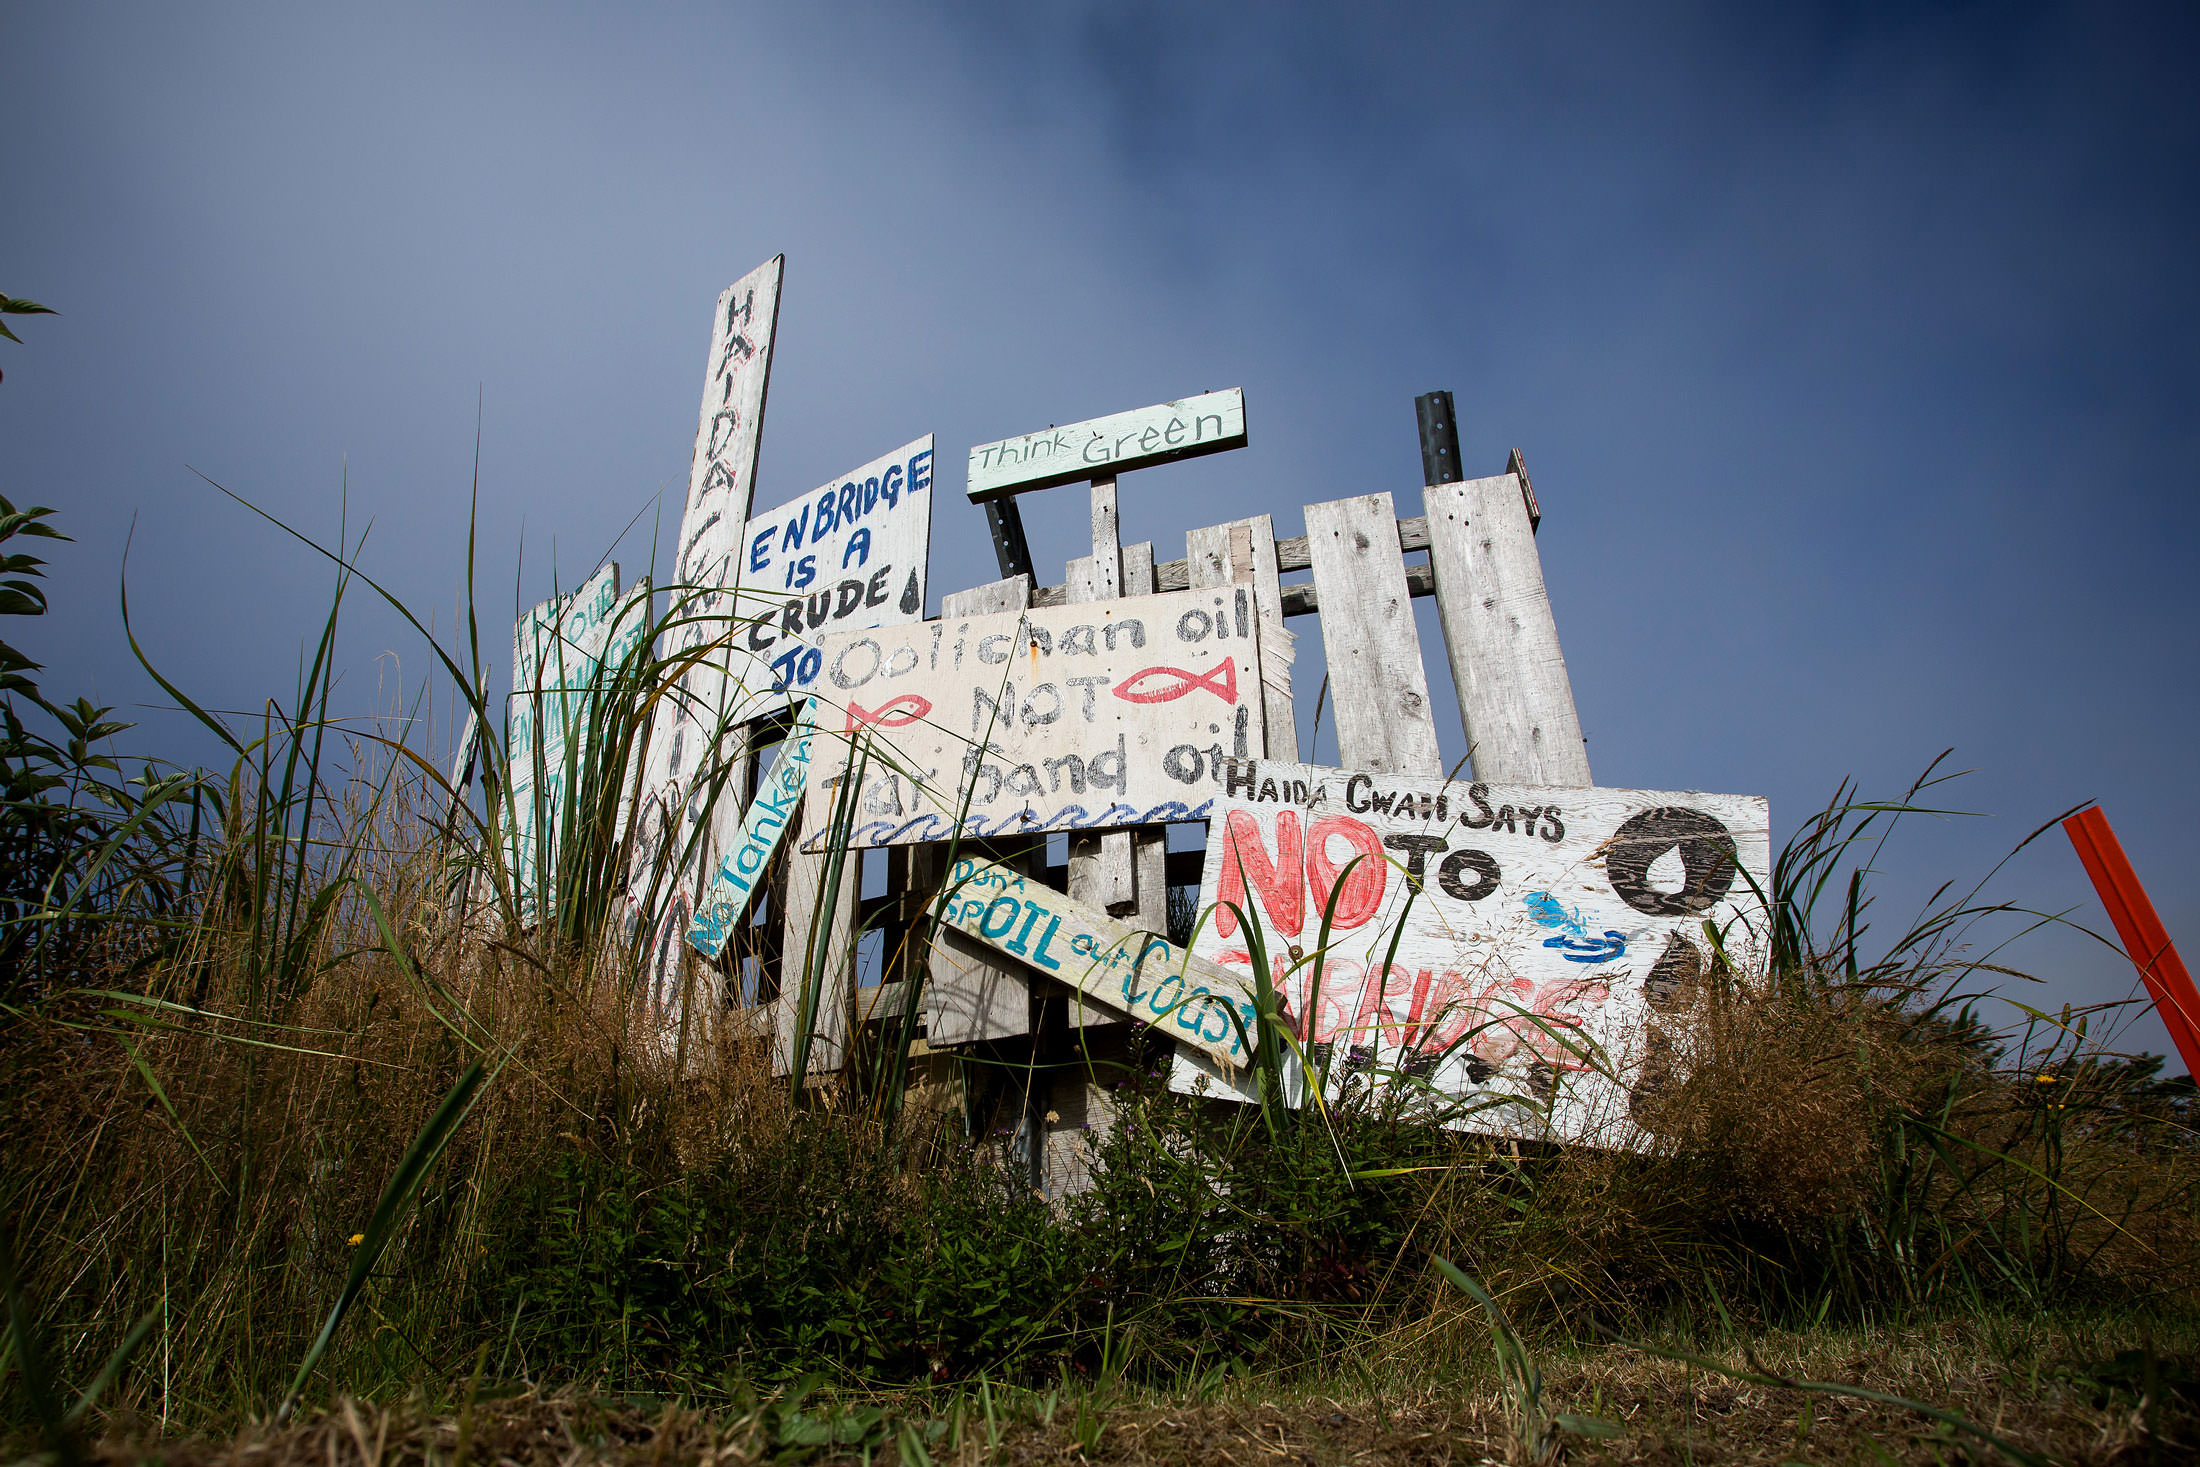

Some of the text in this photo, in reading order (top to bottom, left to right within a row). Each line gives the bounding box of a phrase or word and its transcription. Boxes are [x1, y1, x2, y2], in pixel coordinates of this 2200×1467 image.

[696, 288, 755, 510] HAIDA
[979, 414, 1222, 469] Think Green
[750, 449, 933, 573] ENBRIDGE
[786, 528, 871, 593] IS A
[748, 565, 892, 651] CRUDE
[829, 589, 1249, 690] Oolichan oil
[769, 645, 822, 696] JO
[972, 676, 1111, 733] NOT
[1163, 704, 1249, 785] oil
[1460, 783, 1566, 844] SAYS
[1216, 809, 1501, 939] NO TO
[686, 902, 735, 955] No
[1211, 947, 1610, 1072] NBRIDGE
